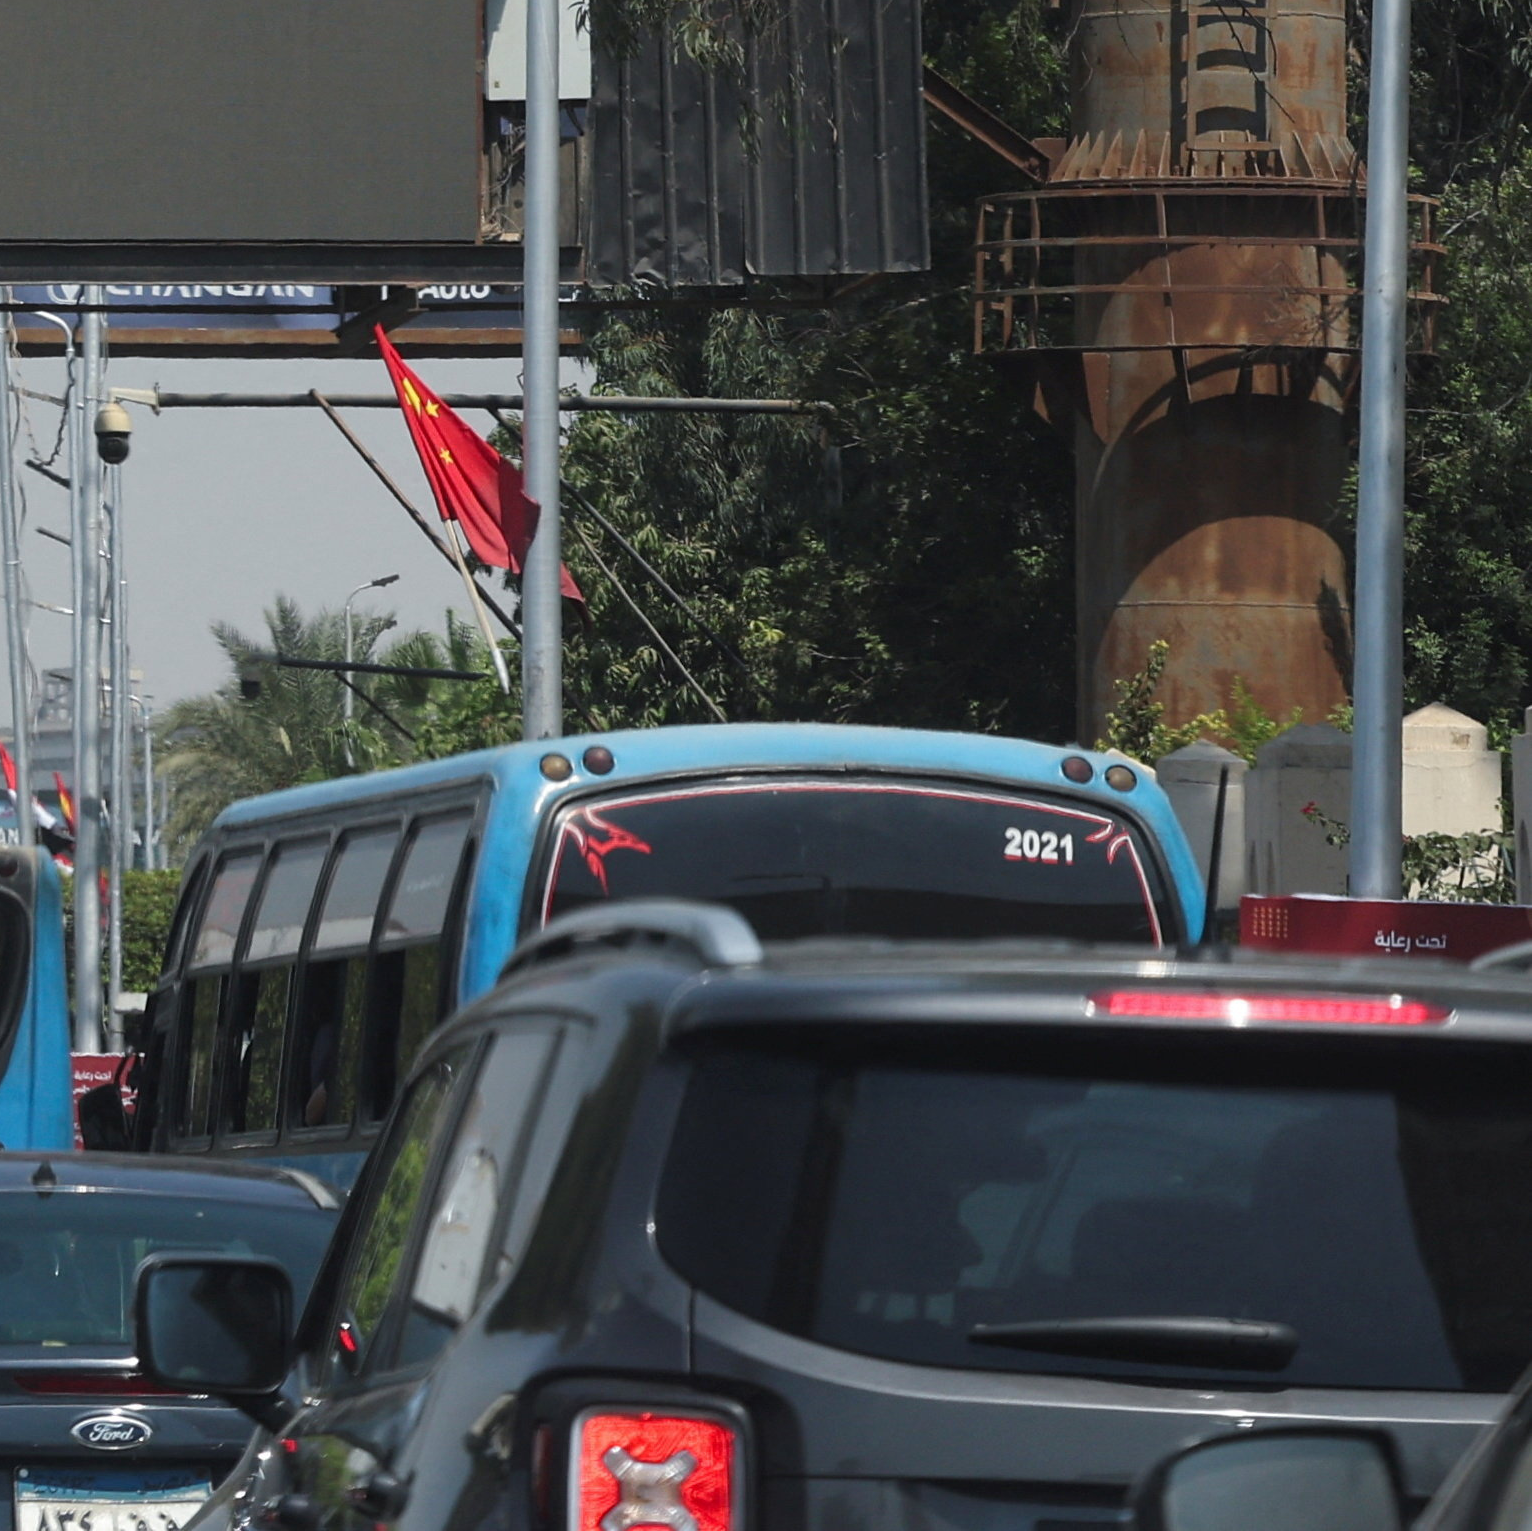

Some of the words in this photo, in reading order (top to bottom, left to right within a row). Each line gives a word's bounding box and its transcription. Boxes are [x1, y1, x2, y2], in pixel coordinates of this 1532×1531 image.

[1003, 826, 1075, 865] 2021
[1374, 930, 1411, 953] رعاية
[1415, 934, 1448, 949] تحت
[89, 1423, 135, 1442] Ford
